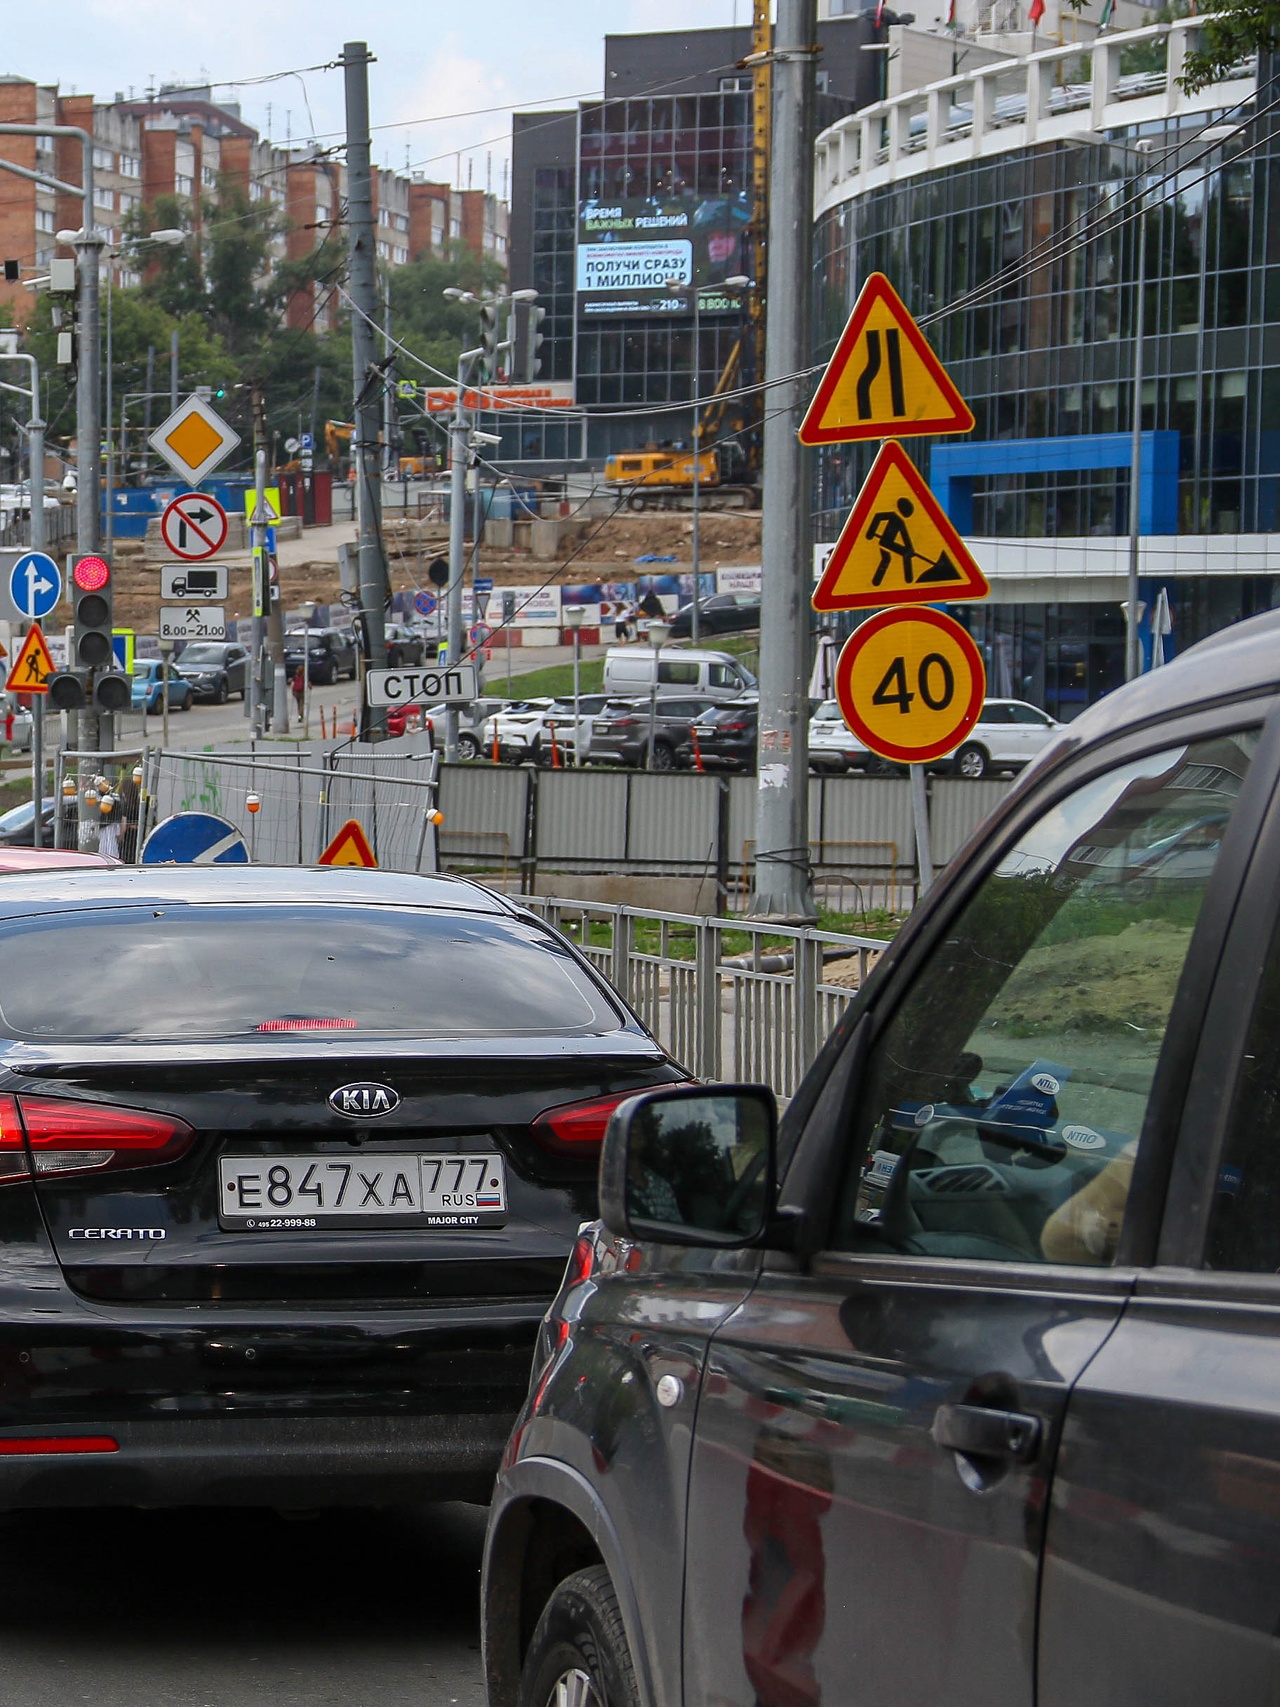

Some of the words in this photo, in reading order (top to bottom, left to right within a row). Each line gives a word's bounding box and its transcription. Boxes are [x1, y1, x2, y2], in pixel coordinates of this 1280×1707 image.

[585, 206, 622, 220] ВРЕМЯ
[585, 217, 634, 231] ВАЖНЫХ
[635, 212, 688, 228] РЕШЕНИЙ
[586, 260, 640, 273] ПОЛУЧИ
[644, 257, 687, 270] СРАЗУ
[586, 276, 592, 287] 1
[660, 299, 680, 310] 210
[383, 672, 462, 700] СТОП
[871, 651, 955, 715] 40
[341, 1089, 391, 1110] KIA
[422, 1158, 489, 1194] 777
[441, 1194, 475, 1207] RUS
[270, 1218, 317, 1228] 22-999-88
[427, 1216, 458, 1225] MAJOR
[459, 1215, 479, 1224] CITY
[68, 1226, 167, 1241] CERATO
